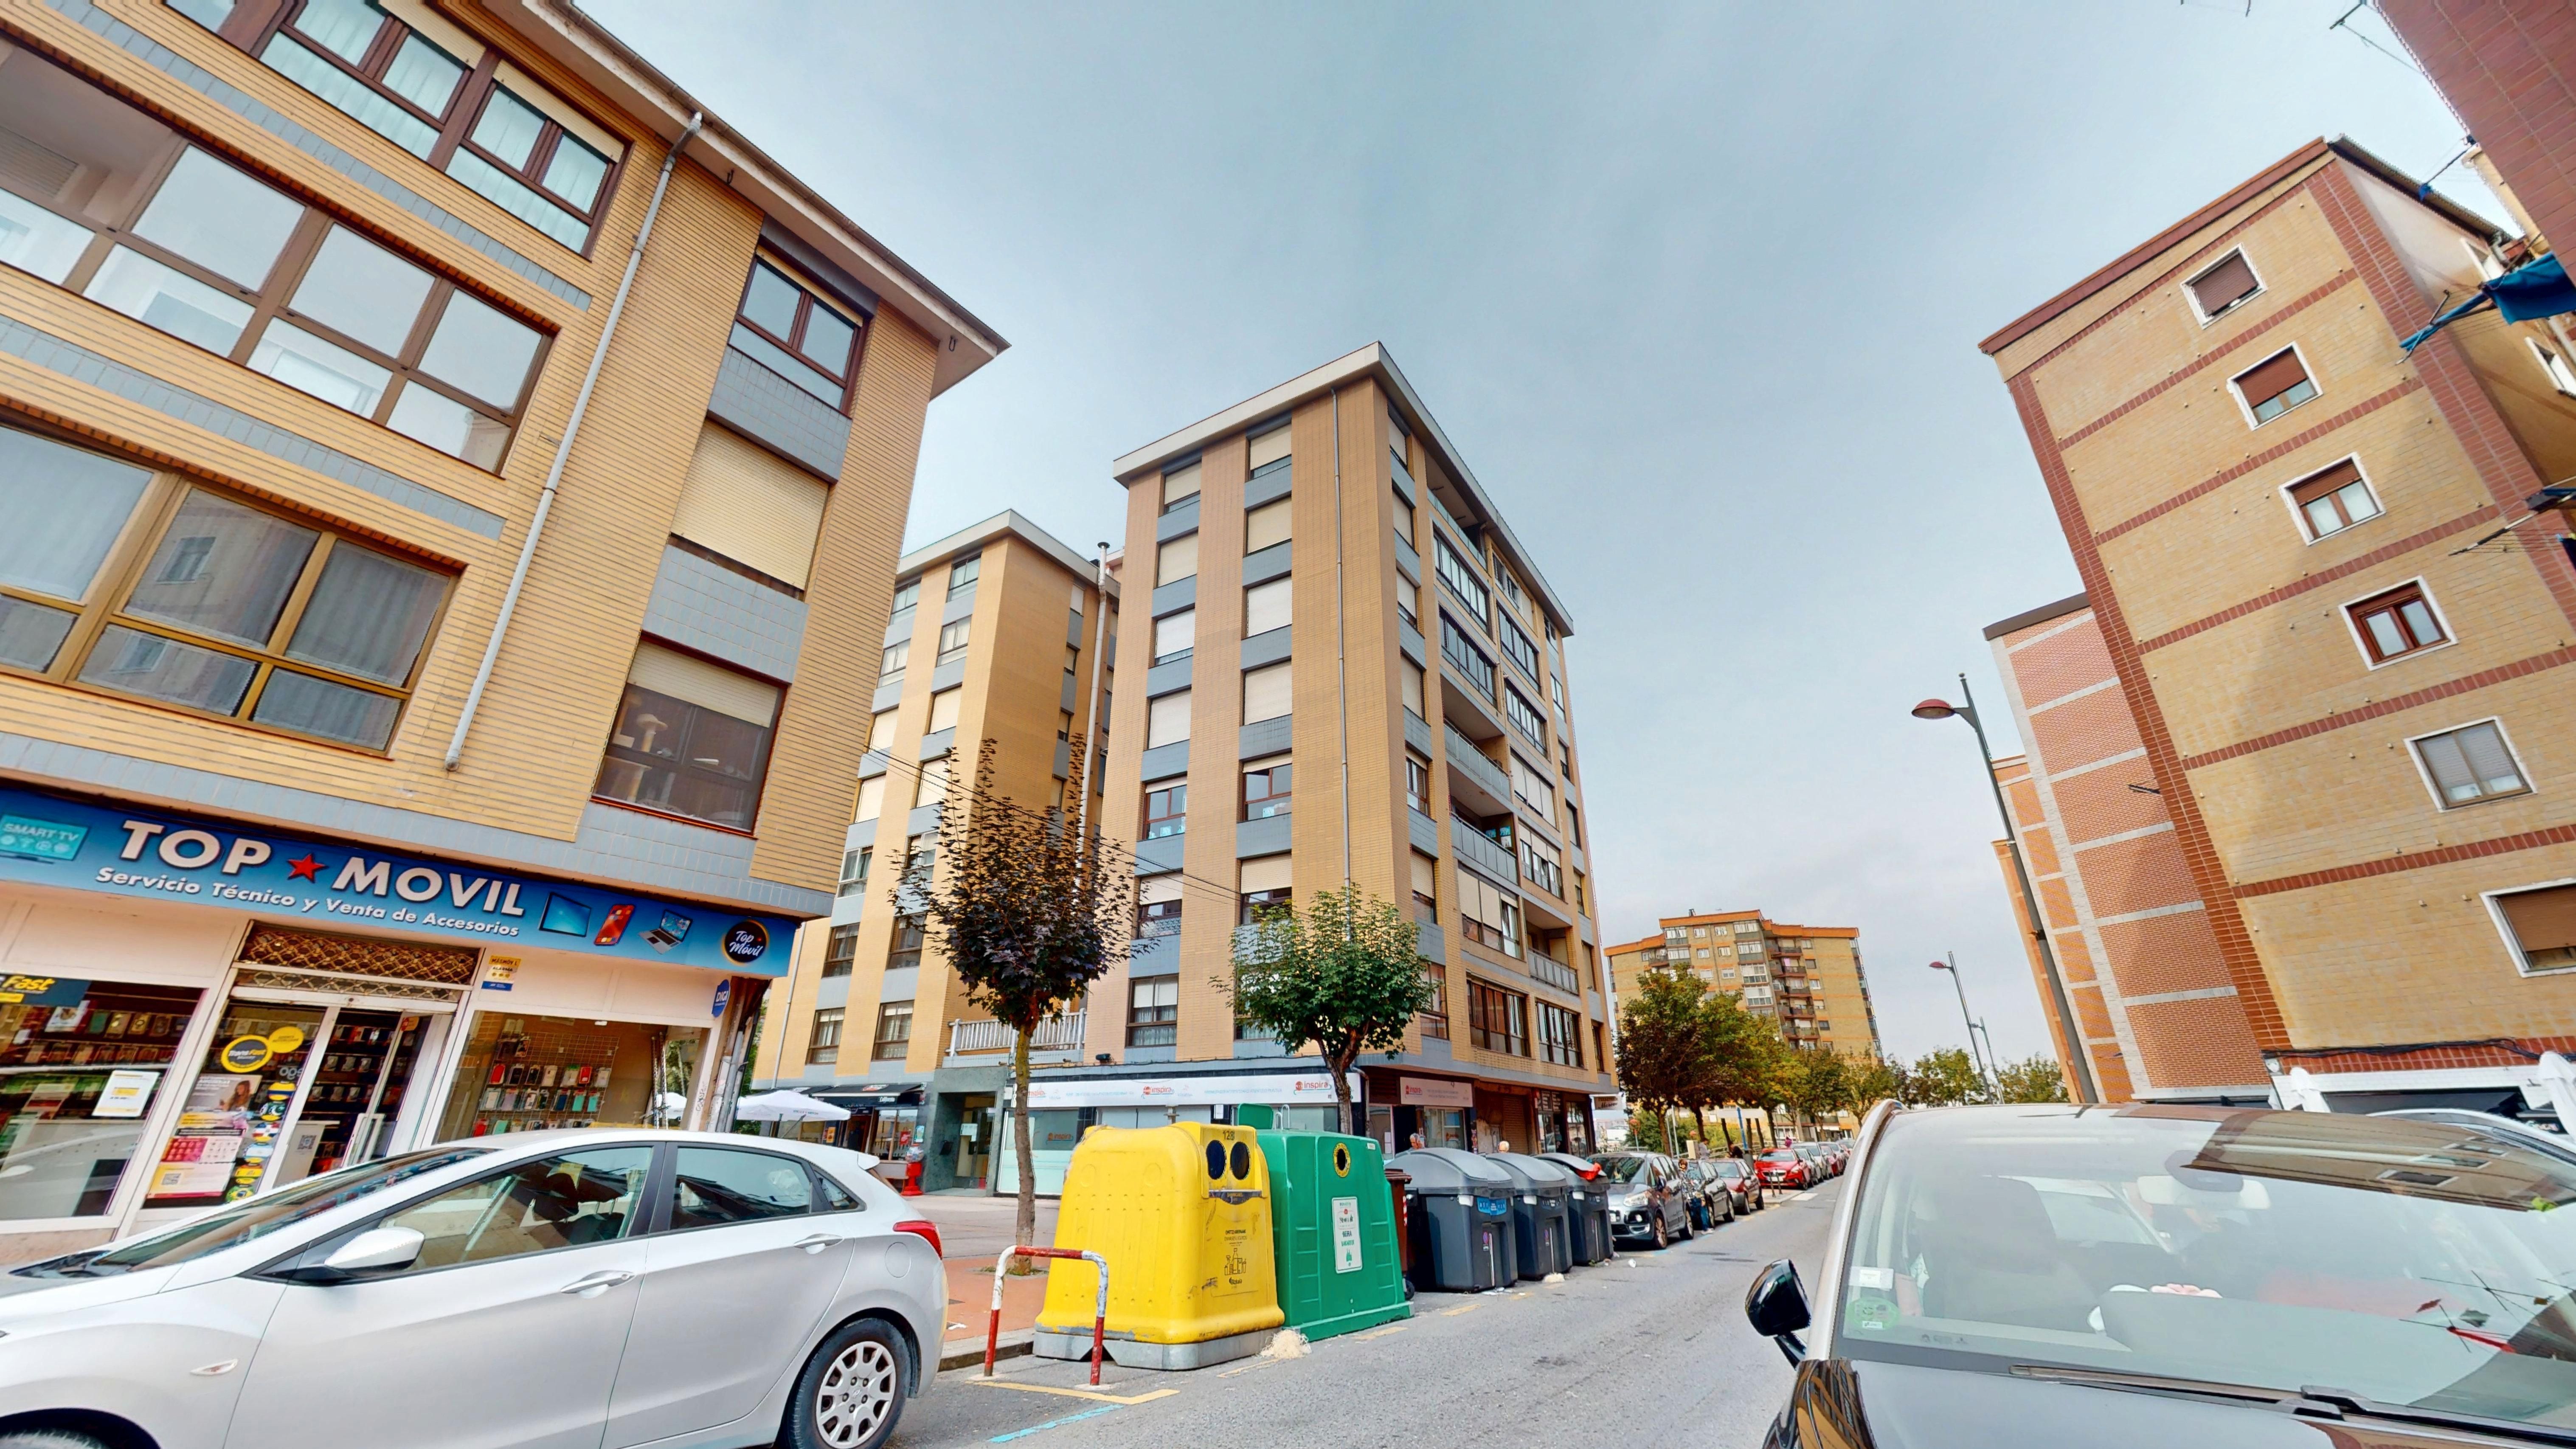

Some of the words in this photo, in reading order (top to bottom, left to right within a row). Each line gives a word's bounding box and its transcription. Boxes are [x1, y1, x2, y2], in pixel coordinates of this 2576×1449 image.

[3, 823, 56, 838] SMART
[59, 831, 79, 841] TV
[120, 820, 271, 875] TOP
[332, 857, 524, 916] MOVIL
[96, 867, 201, 894] Servicio
[212, 882, 296, 906] Técnico
[301, 898, 318, 912] y
[326, 898, 386, 919] Venta
[392, 907, 417, 923] de
[422, 912, 520, 937] Accesorios
[736, 930, 755, 943] Top
[729, 942, 764, 957] Móvil
[1, 975, 55, 990] Fast
[715, 990, 729, 1002] DIGI
[1304, 1081, 1328, 1090] inspira
